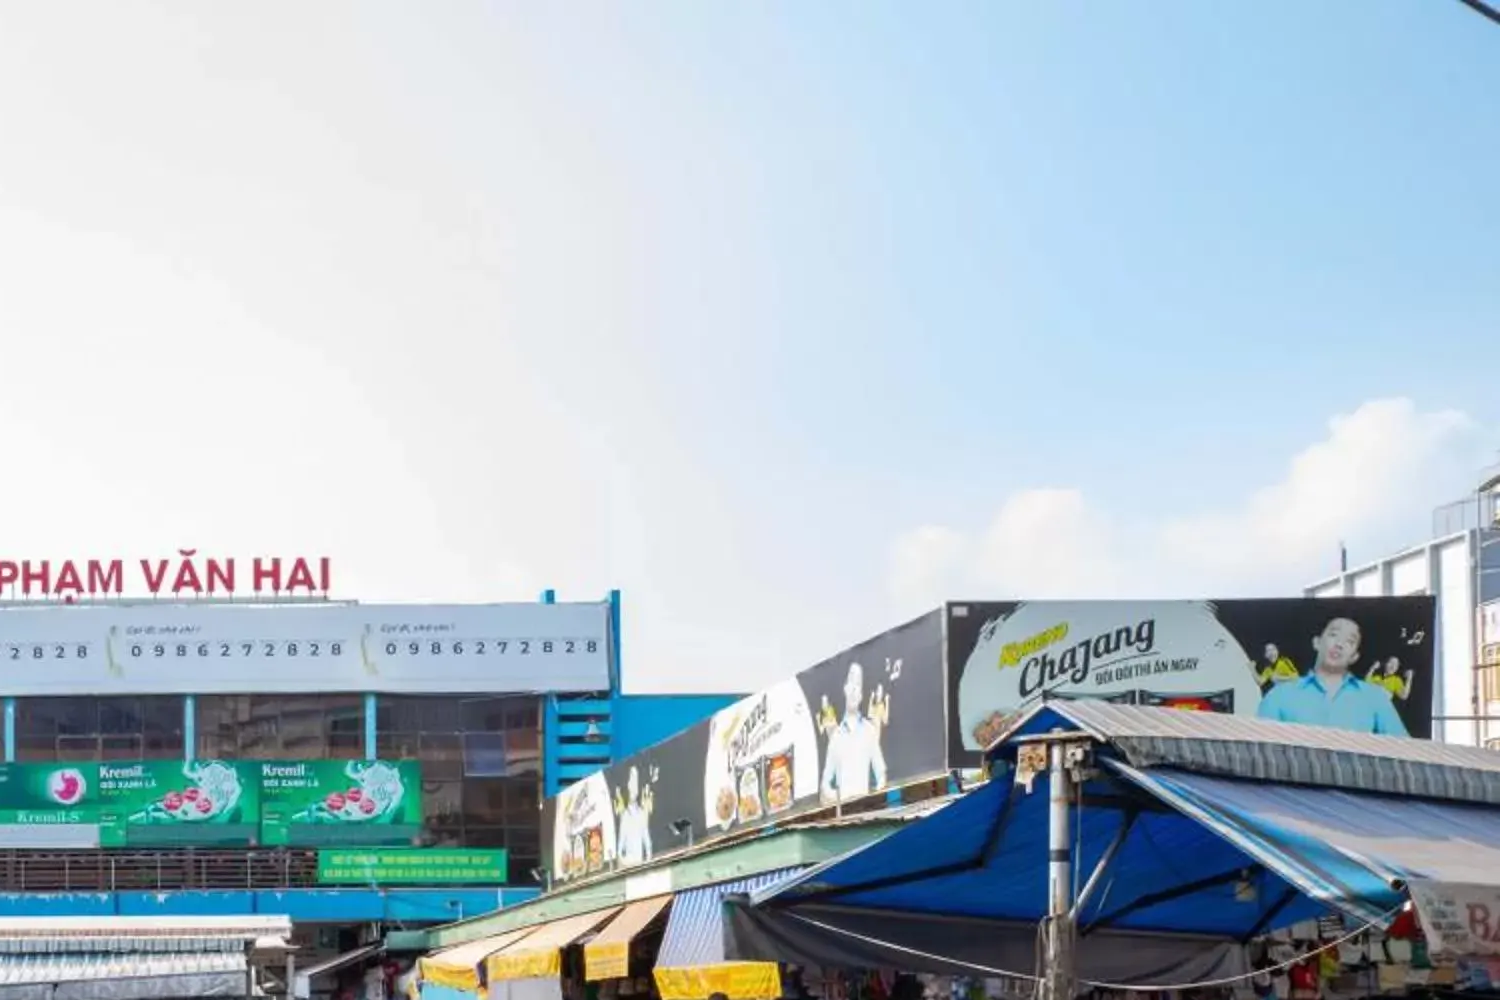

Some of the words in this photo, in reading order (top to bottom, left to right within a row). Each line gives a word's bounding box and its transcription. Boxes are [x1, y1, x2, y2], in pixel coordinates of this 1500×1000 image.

[140, 548, 235, 593] VĂN
[253, 556, 330, 592] HAI
[1019, 619, 1156, 698] Chajang
